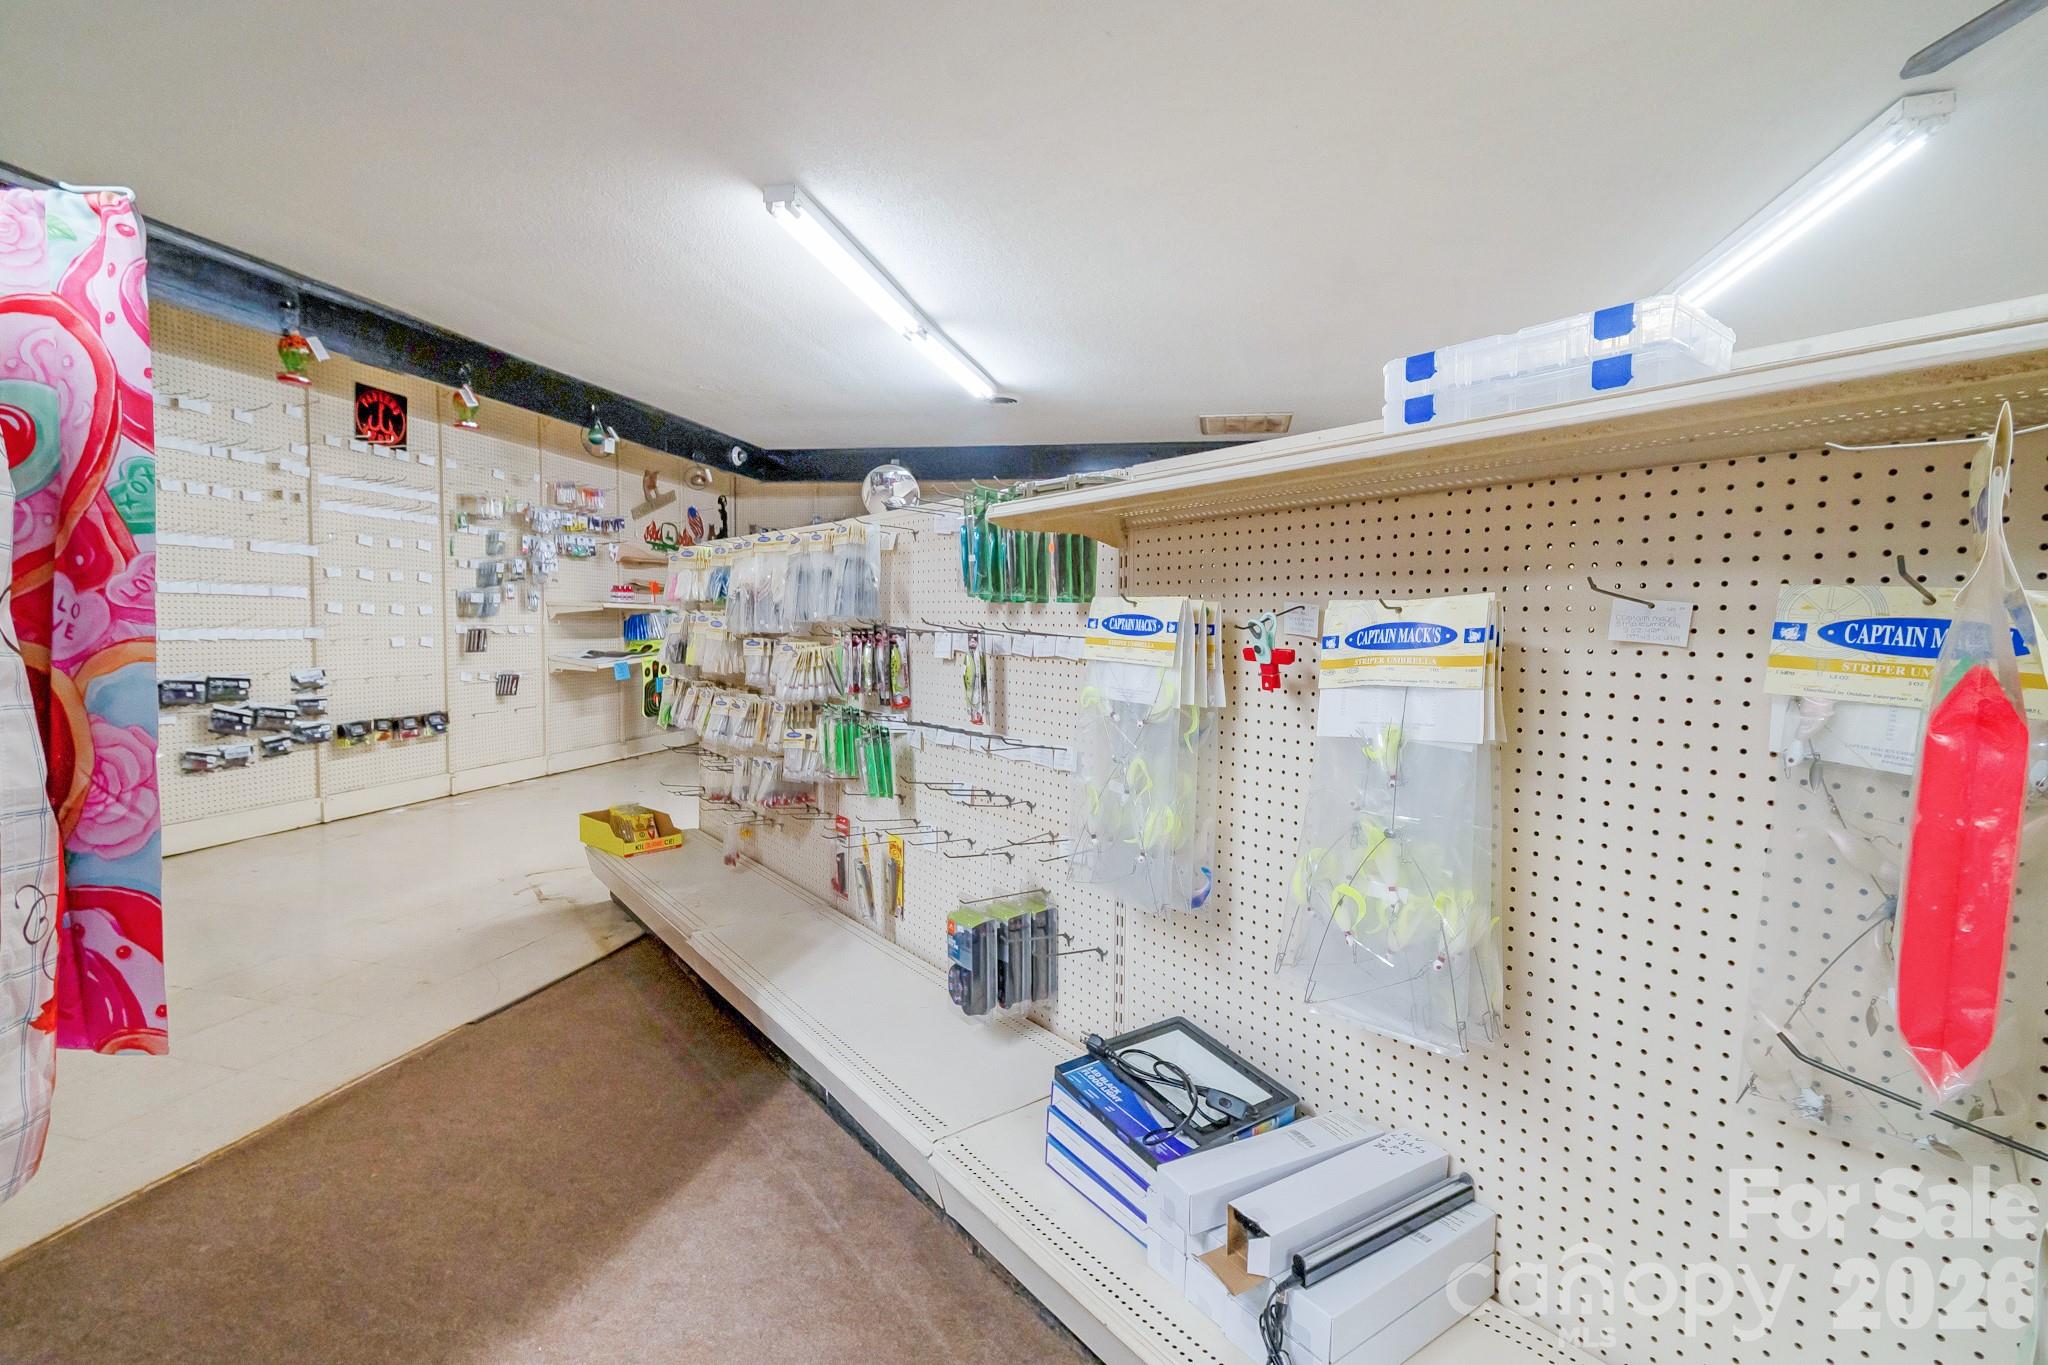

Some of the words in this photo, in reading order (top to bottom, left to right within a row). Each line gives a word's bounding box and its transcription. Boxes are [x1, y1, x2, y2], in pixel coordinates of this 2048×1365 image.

[1109, 617, 1135, 631] CAPTAIN
[1136, 618, 1158, 632] MACK'S
[1356, 627, 1396, 646] CAPTAIN
[1397, 625, 1442, 644] MACK'S
[1844, 622, 1928, 648] CAPTAIN
[1354, 656, 1385, 666] STRIPER
[1386, 656, 1438, 666] UMBRELLA
[1842, 661, 1905, 676] STRIPER
[1087, 1066, 1102, 1078] LED
[1100, 1075, 1122, 1095] BLACK
[1100, 1086, 1124, 1103] LIGHT
